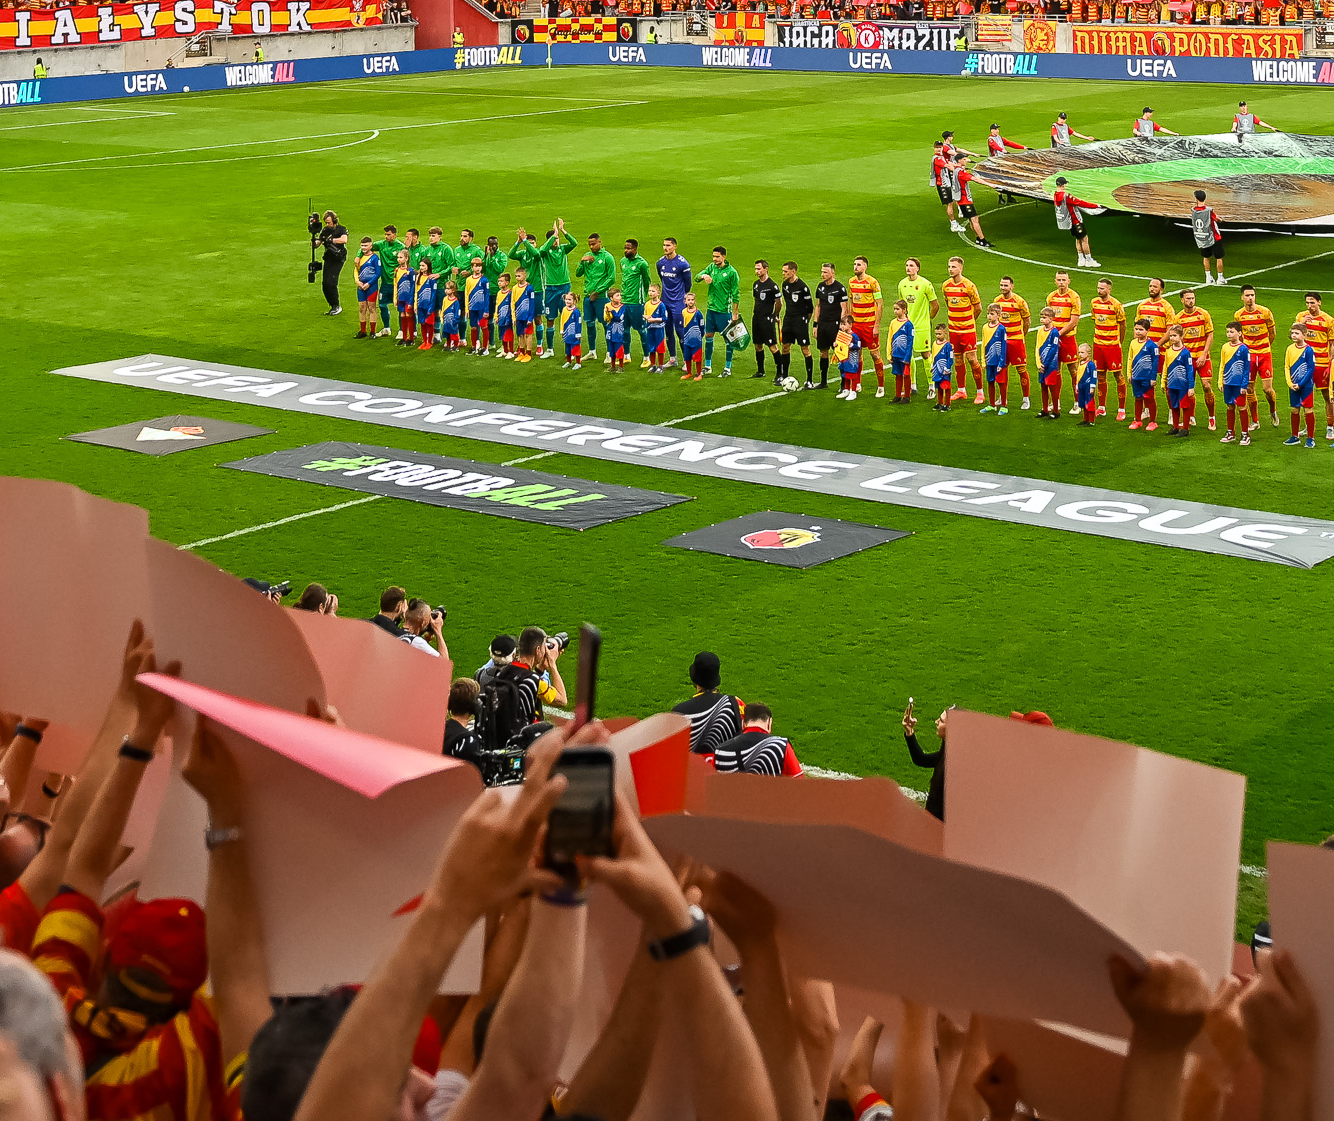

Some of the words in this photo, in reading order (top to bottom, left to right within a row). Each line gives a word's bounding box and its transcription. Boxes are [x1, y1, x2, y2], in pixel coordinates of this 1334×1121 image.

[780, 25, 834, 49] JAGA
[1074, 31, 1148, 56] DUMA
[1173, 32, 1301, 59] PODLASIA
[363, 56, 399, 73] UEFA
[454, 46, 522, 69] #FOOTBALL
[609, 46, 647, 63] UEFA
[702, 47, 750, 67] WELCOME
[750, 49, 772, 67] ALL
[849, 52, 892, 69] UEFA
[964, 53, 1038, 75] #FOOTBALL
[225, 63, 274, 86] WELCOME
[274, 62, 295, 83] ALL
[1127, 59, 1177, 77] UEFA
[1252, 60, 1317, 84] WELCOME
[124, 73, 167, 93] UEFA
[113, 361, 299, 398] UEFA
[298, 389, 861, 481] CONFERENCE
[860, 470, 1310, 551] LEAGUE
[303, 455, 608, 511] #FOOTBALL
